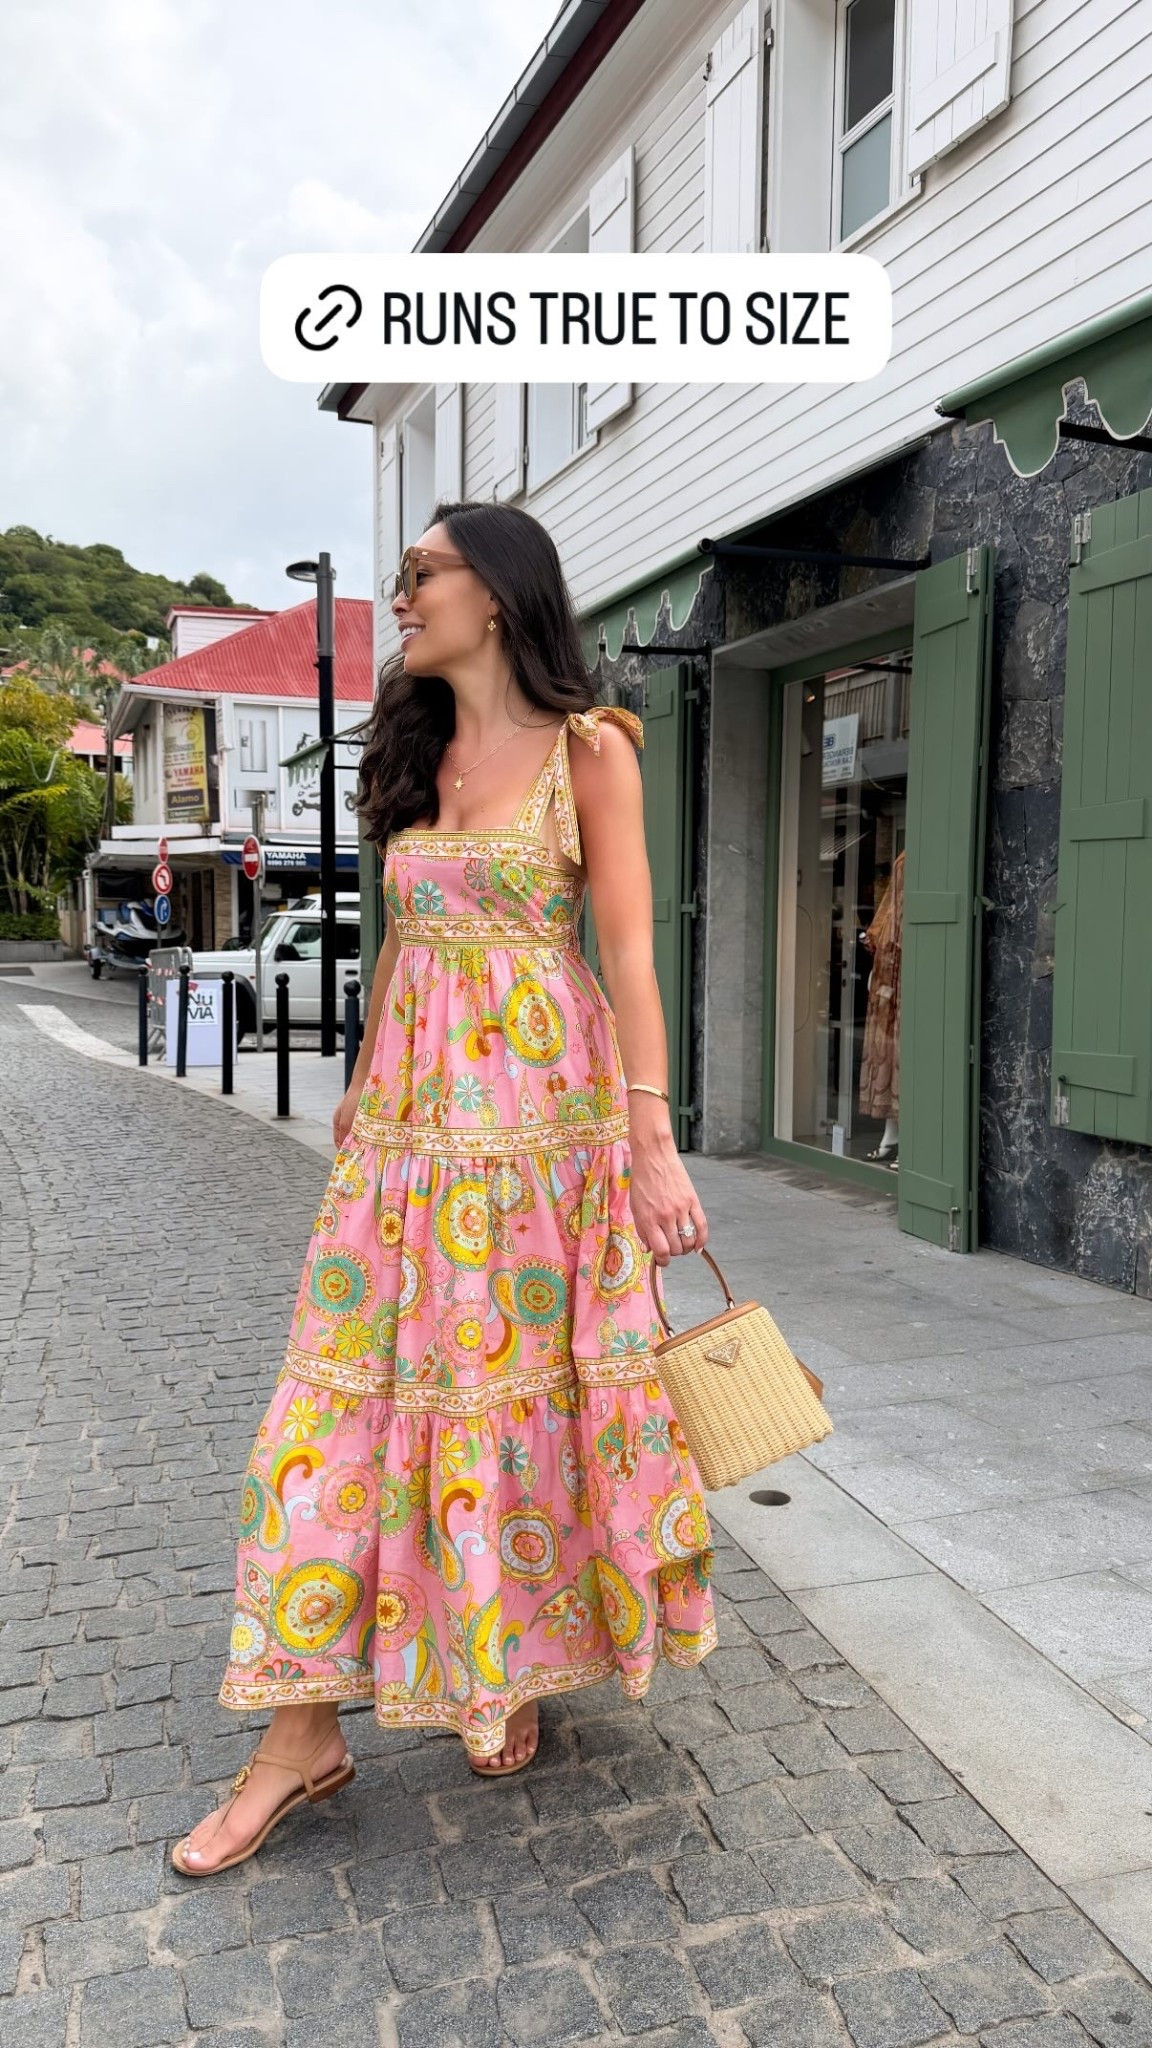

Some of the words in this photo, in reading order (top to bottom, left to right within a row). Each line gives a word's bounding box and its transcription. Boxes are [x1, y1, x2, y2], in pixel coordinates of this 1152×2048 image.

[172, 765, 204, 776] YAMAHA
[171, 795, 200, 804] Alamo
[266, 852, 307, 860] YAMAHA
[187, 1007, 214, 1020] VIA
